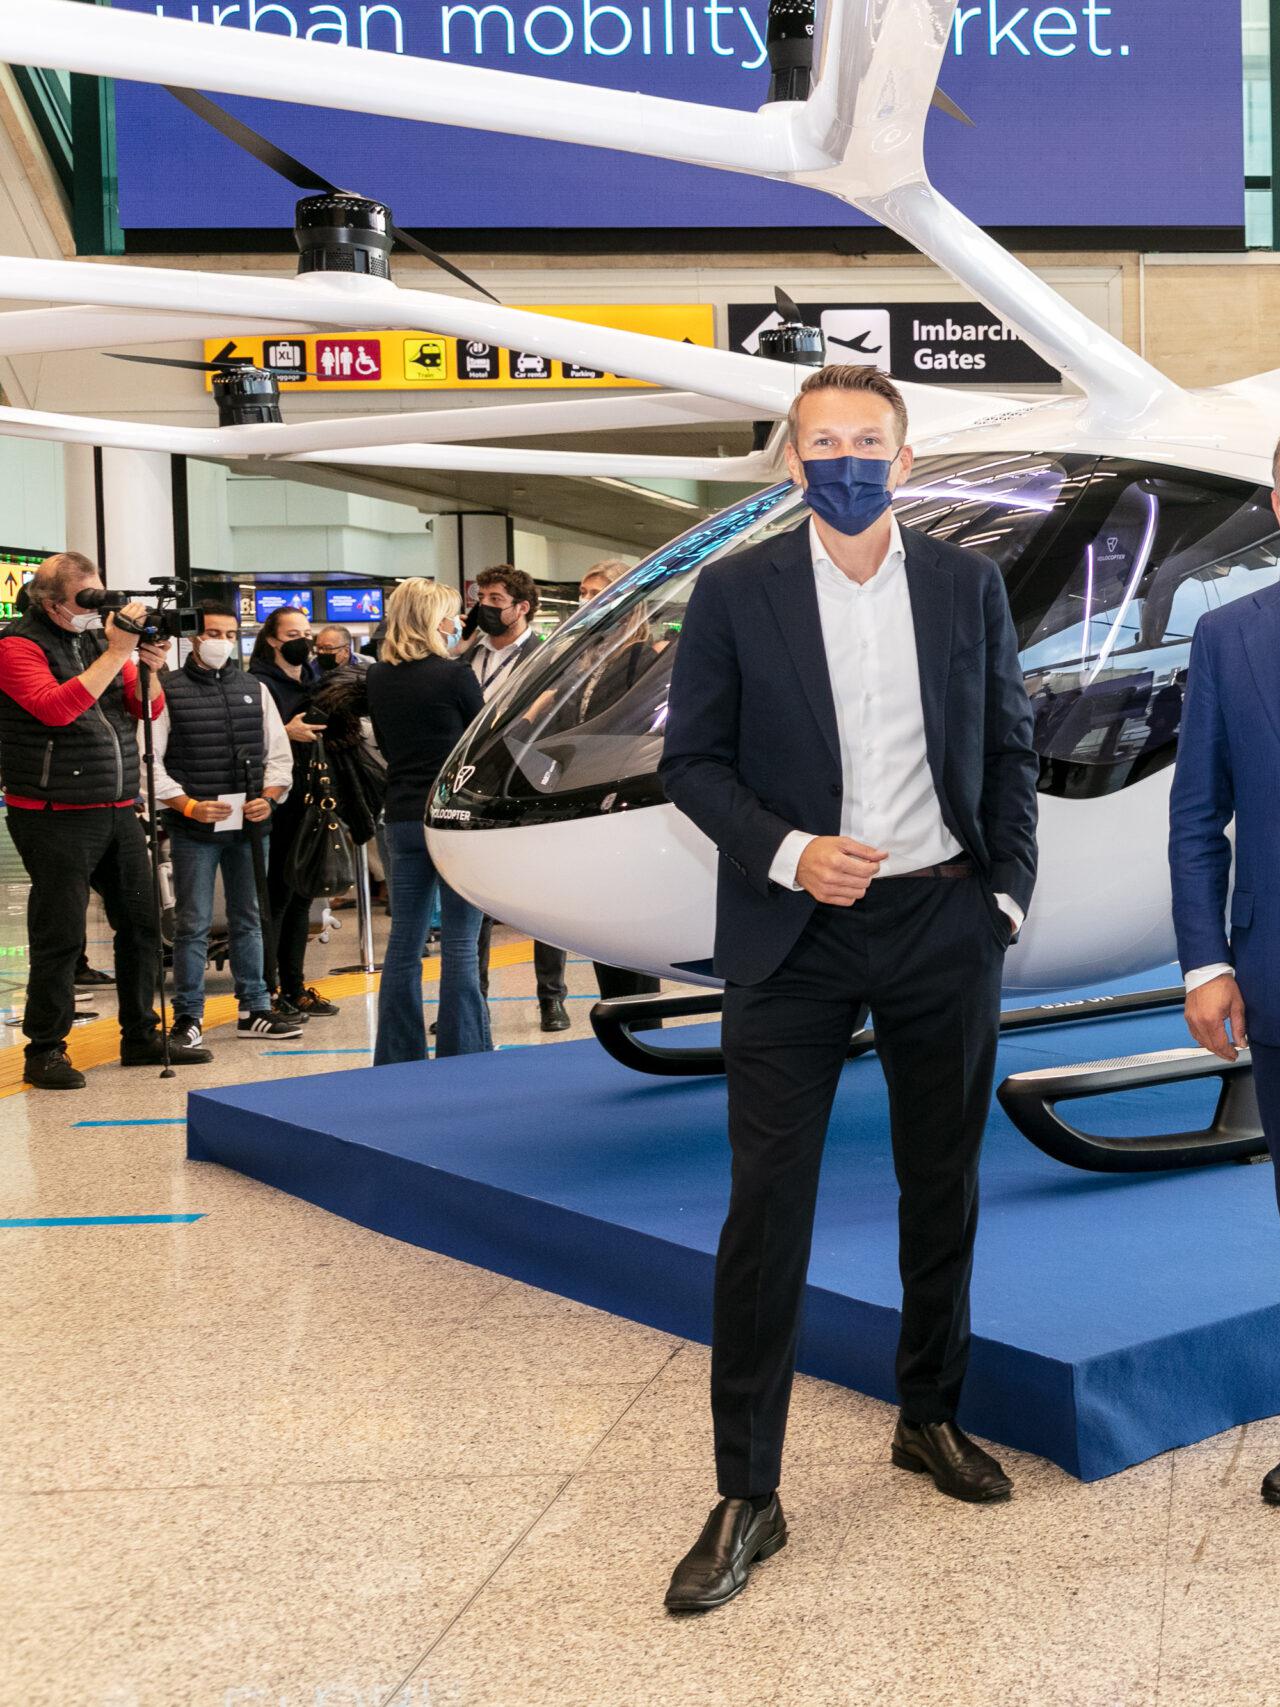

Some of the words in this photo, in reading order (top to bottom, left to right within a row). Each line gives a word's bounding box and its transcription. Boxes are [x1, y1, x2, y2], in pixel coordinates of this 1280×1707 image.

[441, 0, 768, 69] mobility
[278, 350, 292, 361] XL
[914, 347, 987, 370] Gates
[468, 371, 488, 379] Hotel
[514, 371, 528, 379] Car
[529, 371, 548, 379] rental
[570, 370, 596, 380] Parking
